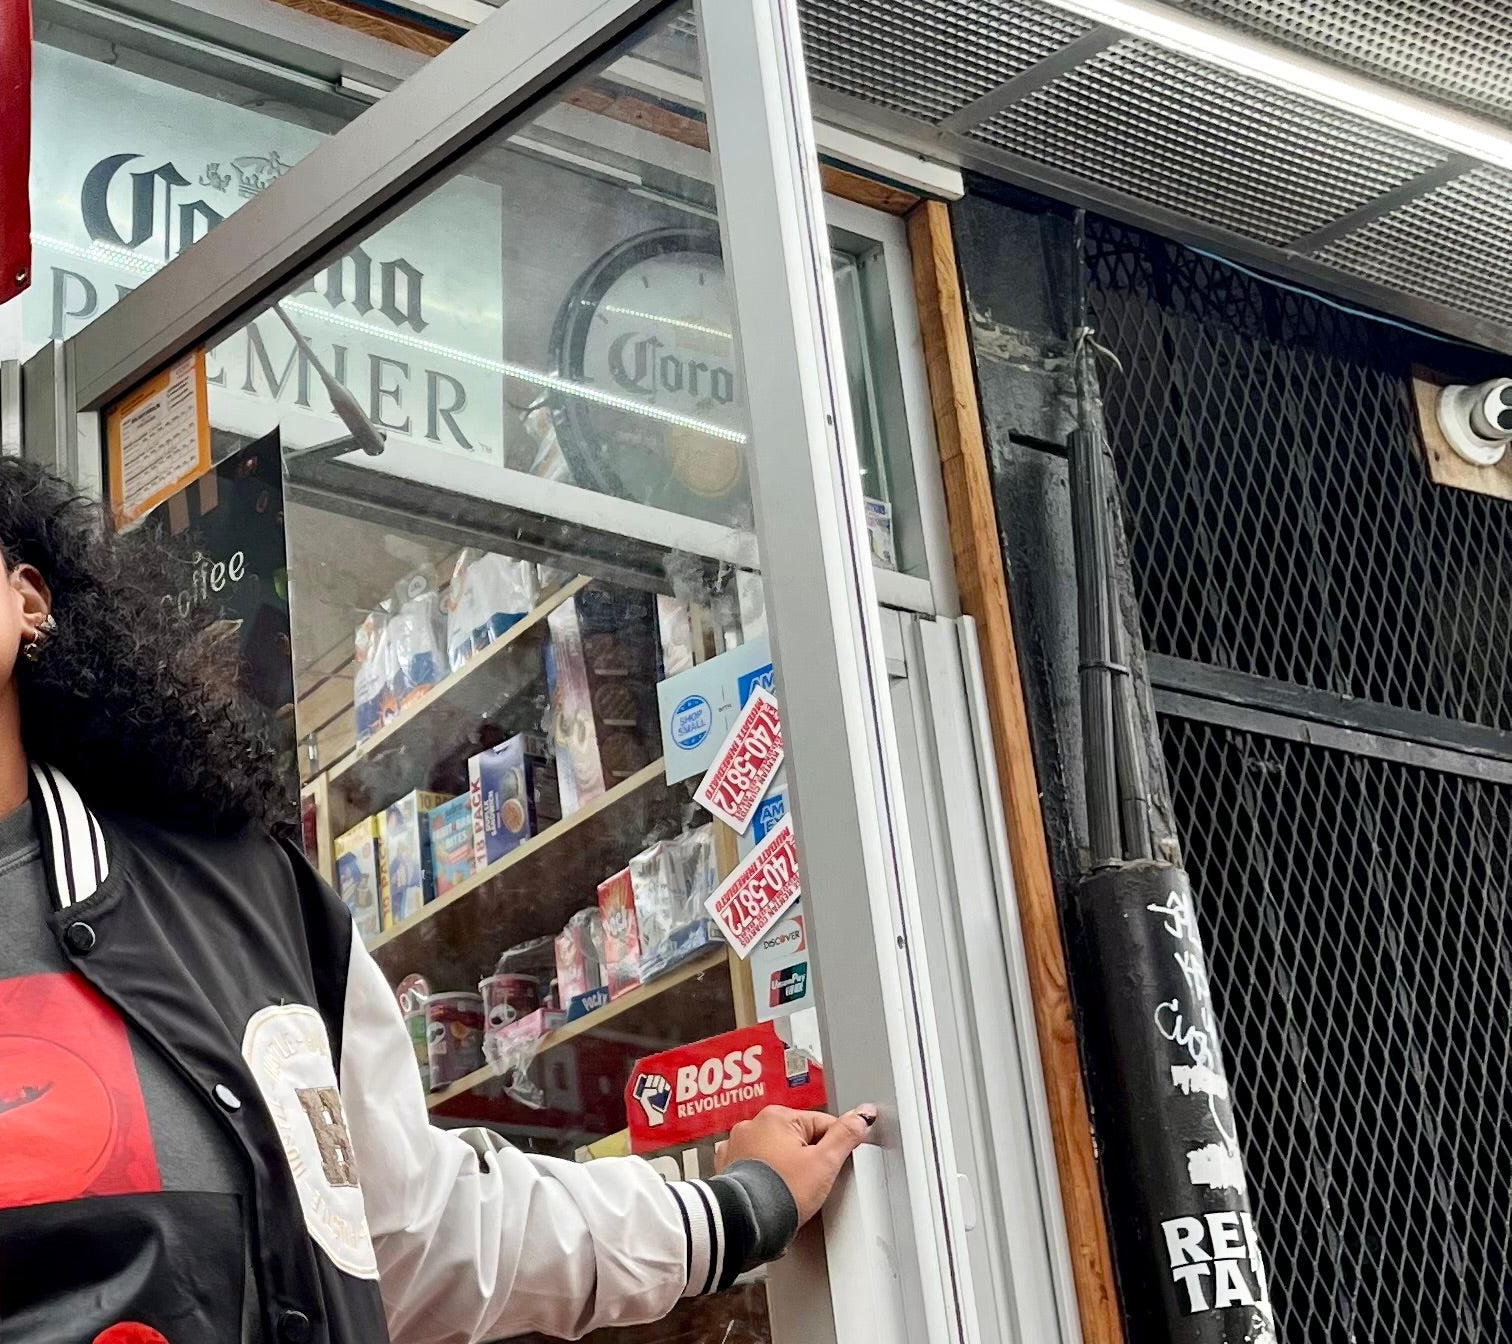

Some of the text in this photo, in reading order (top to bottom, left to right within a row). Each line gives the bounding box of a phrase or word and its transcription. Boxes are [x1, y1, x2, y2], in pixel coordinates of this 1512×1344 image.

[470, 778, 484, 834] PACK
[763, 930, 801, 950] DISCOVER
[675, 1045, 763, 1103] BOSS
[677, 1081, 765, 1119] REVOLUTION
